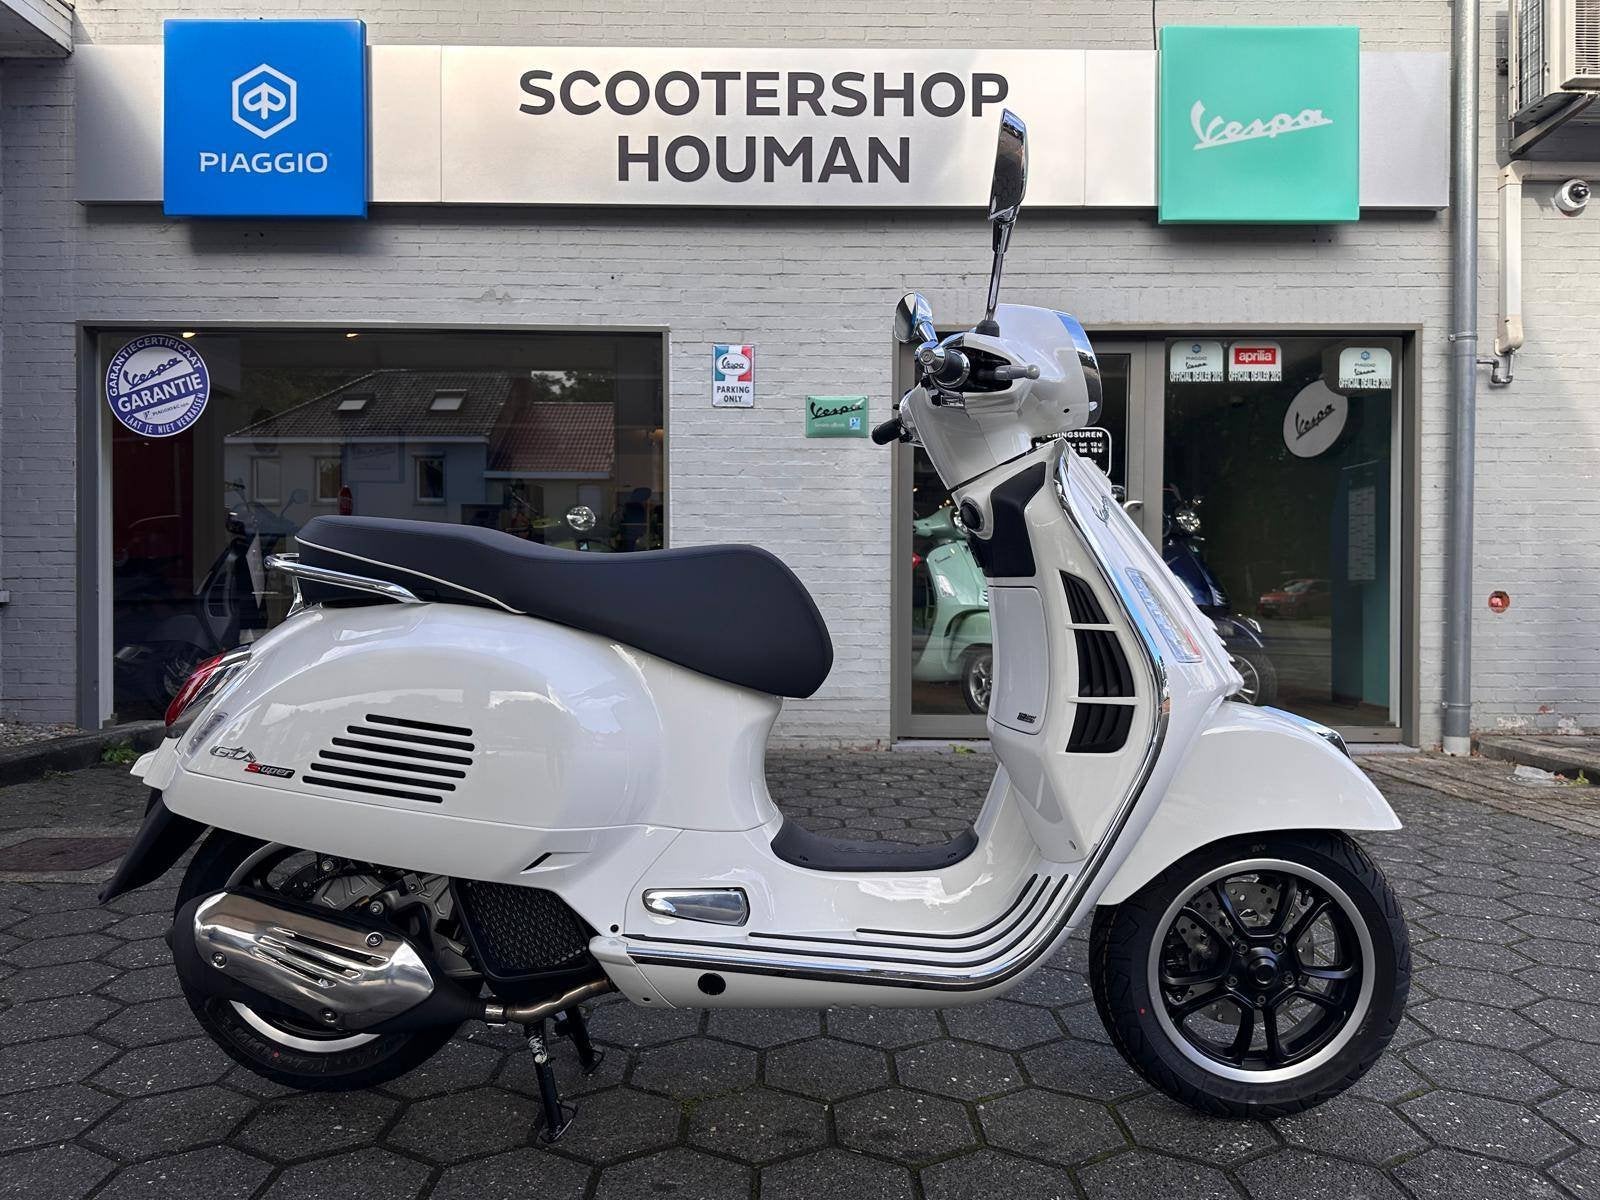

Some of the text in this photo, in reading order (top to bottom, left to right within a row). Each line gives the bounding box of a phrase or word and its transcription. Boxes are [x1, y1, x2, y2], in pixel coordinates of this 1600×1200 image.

[519, 69, 1009, 118] SCOOTERSHOP
[1190, 99, 1333, 151] Vespa
[199, 152, 328, 173] PIAGGIO
[617, 134, 910, 184] HOUMAN
[109, 336, 202, 397] GARANTIECERTIFICAAT
[721, 356, 745, 370] Vespa
[1238, 350, 1272, 363] aprilia
[123, 357, 183, 391] Vespa
[1170, 371, 1192, 382] OFFICIAL
[1193, 371, 1211, 382] DEALER
[1228, 371, 1250, 382] OFFICIAL
[1251, 371, 1269, 382] DEALER
[117, 373, 203, 413] GARANTIE
[716, 385, 750, 394] PARKING
[723, 395, 743, 403] ONLY
[125, 414, 142, 430] LAAT
[144, 424, 153, 434] JE
[158, 423, 176, 434] NIET
[176, 392, 206, 426] VERRASSEN
[810, 401, 864, 420] Vespa
[1296, 404, 1336, 440] Vespa
[244, 763, 293, 777] Super
